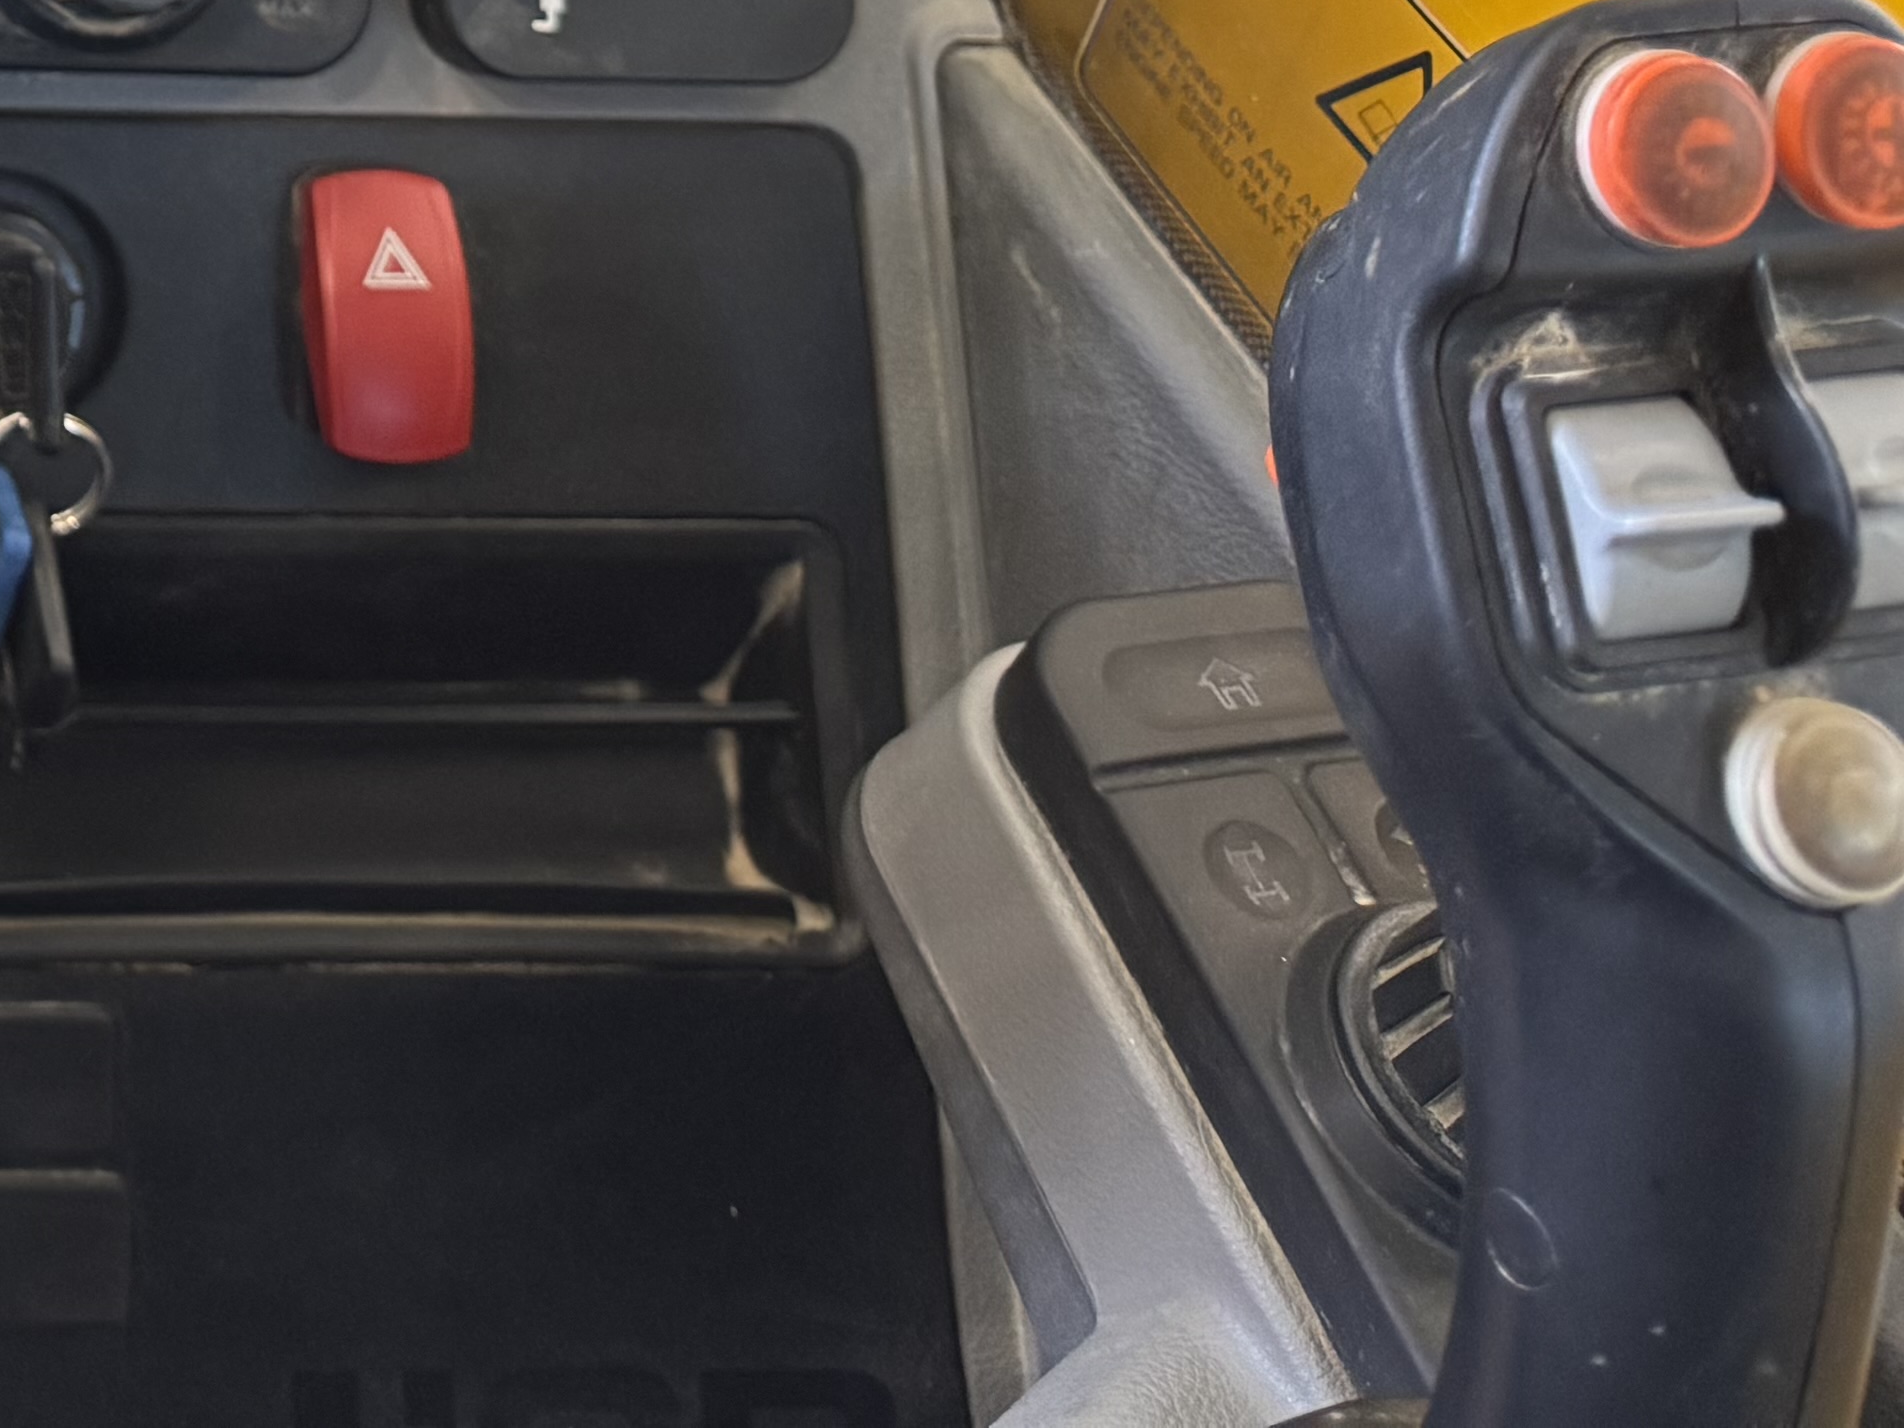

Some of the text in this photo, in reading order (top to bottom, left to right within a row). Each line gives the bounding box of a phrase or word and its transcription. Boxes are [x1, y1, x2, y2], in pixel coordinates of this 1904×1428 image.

[1226, 106, 1255, 142] ON
[1259, 147, 1292, 186] AIR
[1239, 154, 1274, 193] AN
[1234, 178, 1286, 237] MAY
